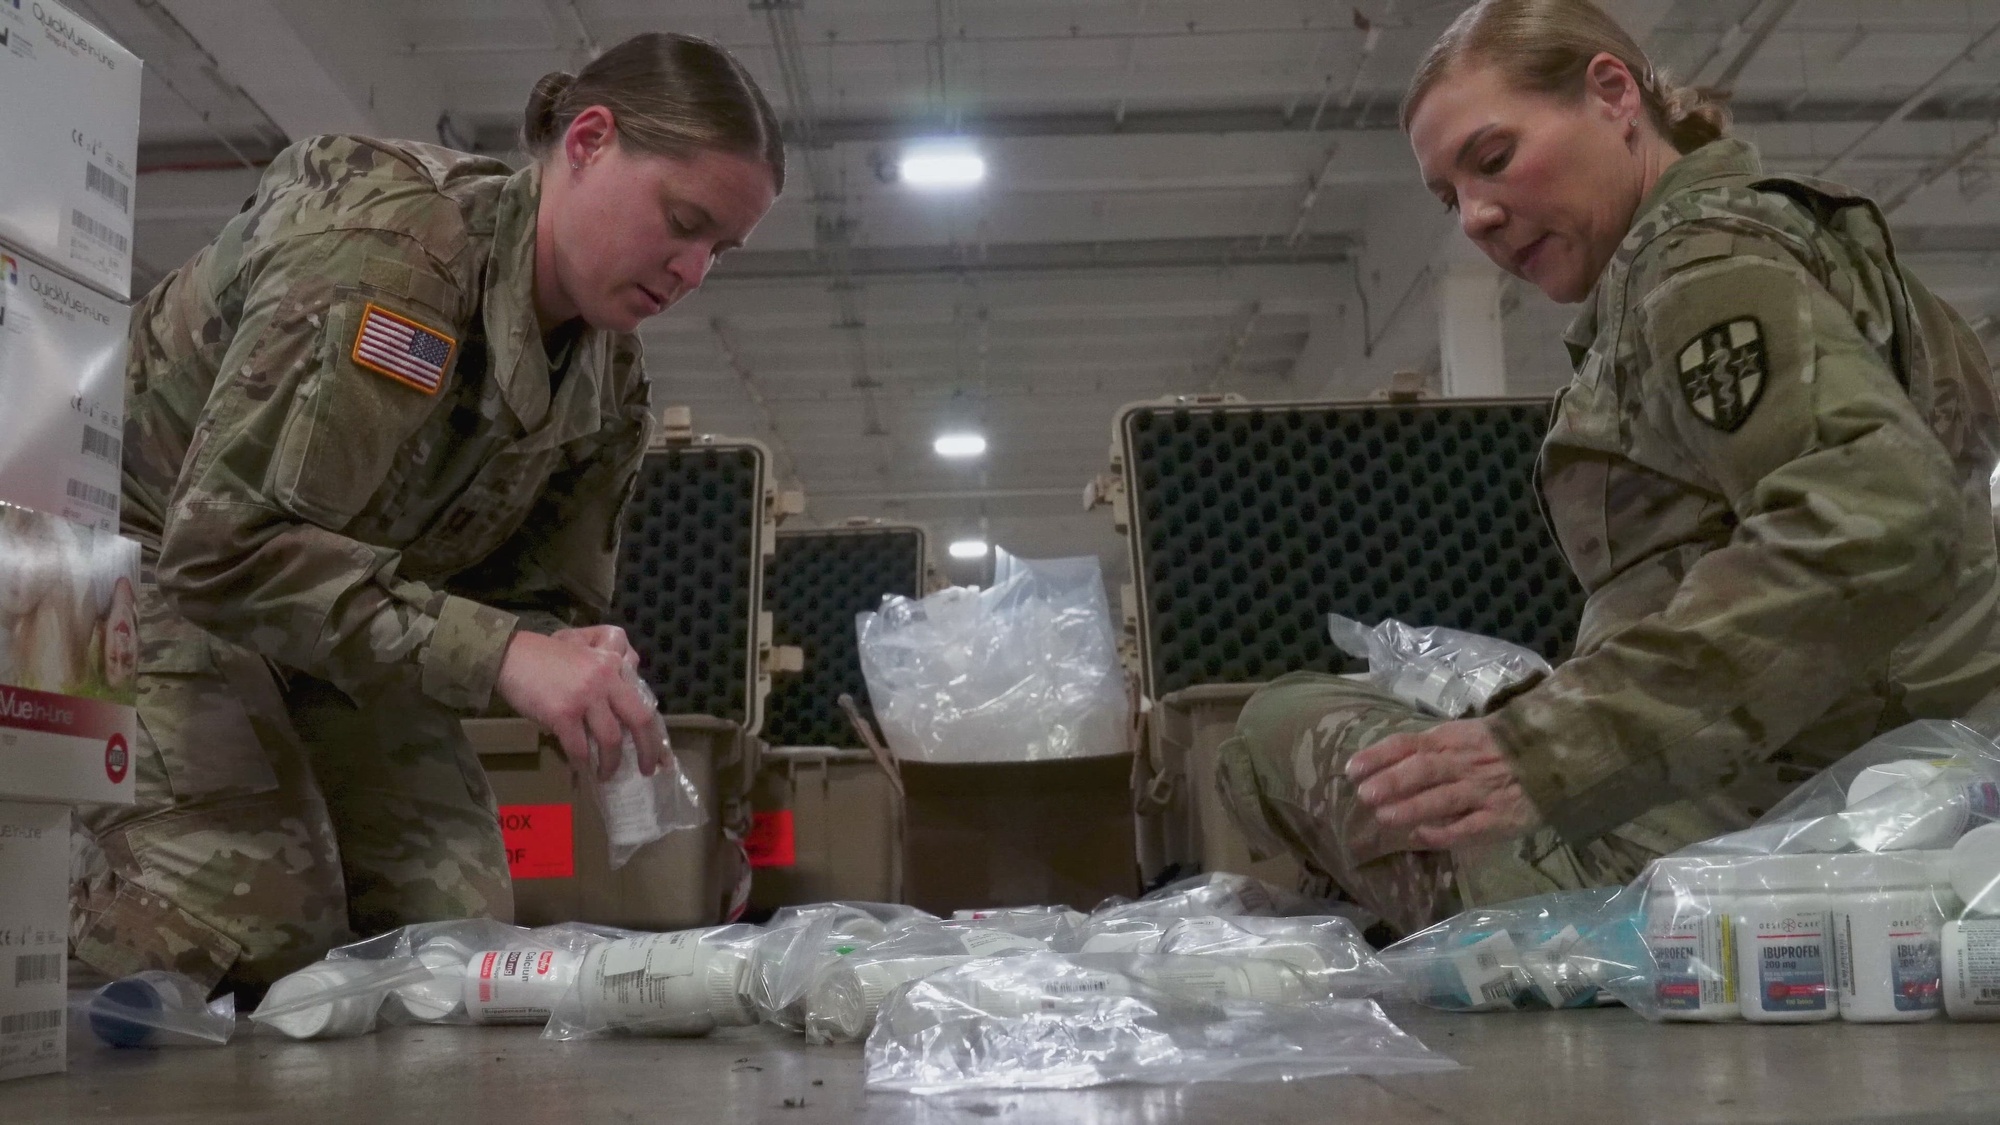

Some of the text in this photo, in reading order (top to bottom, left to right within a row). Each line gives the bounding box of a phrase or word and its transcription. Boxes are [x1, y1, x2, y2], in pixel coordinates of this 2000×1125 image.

[0, 690, 33, 719] Vue
[1763, 945, 1820, 959] IBUPROFEN
[504, 963, 514, 975] mg
[1765, 960, 1797, 969] 200 mg
